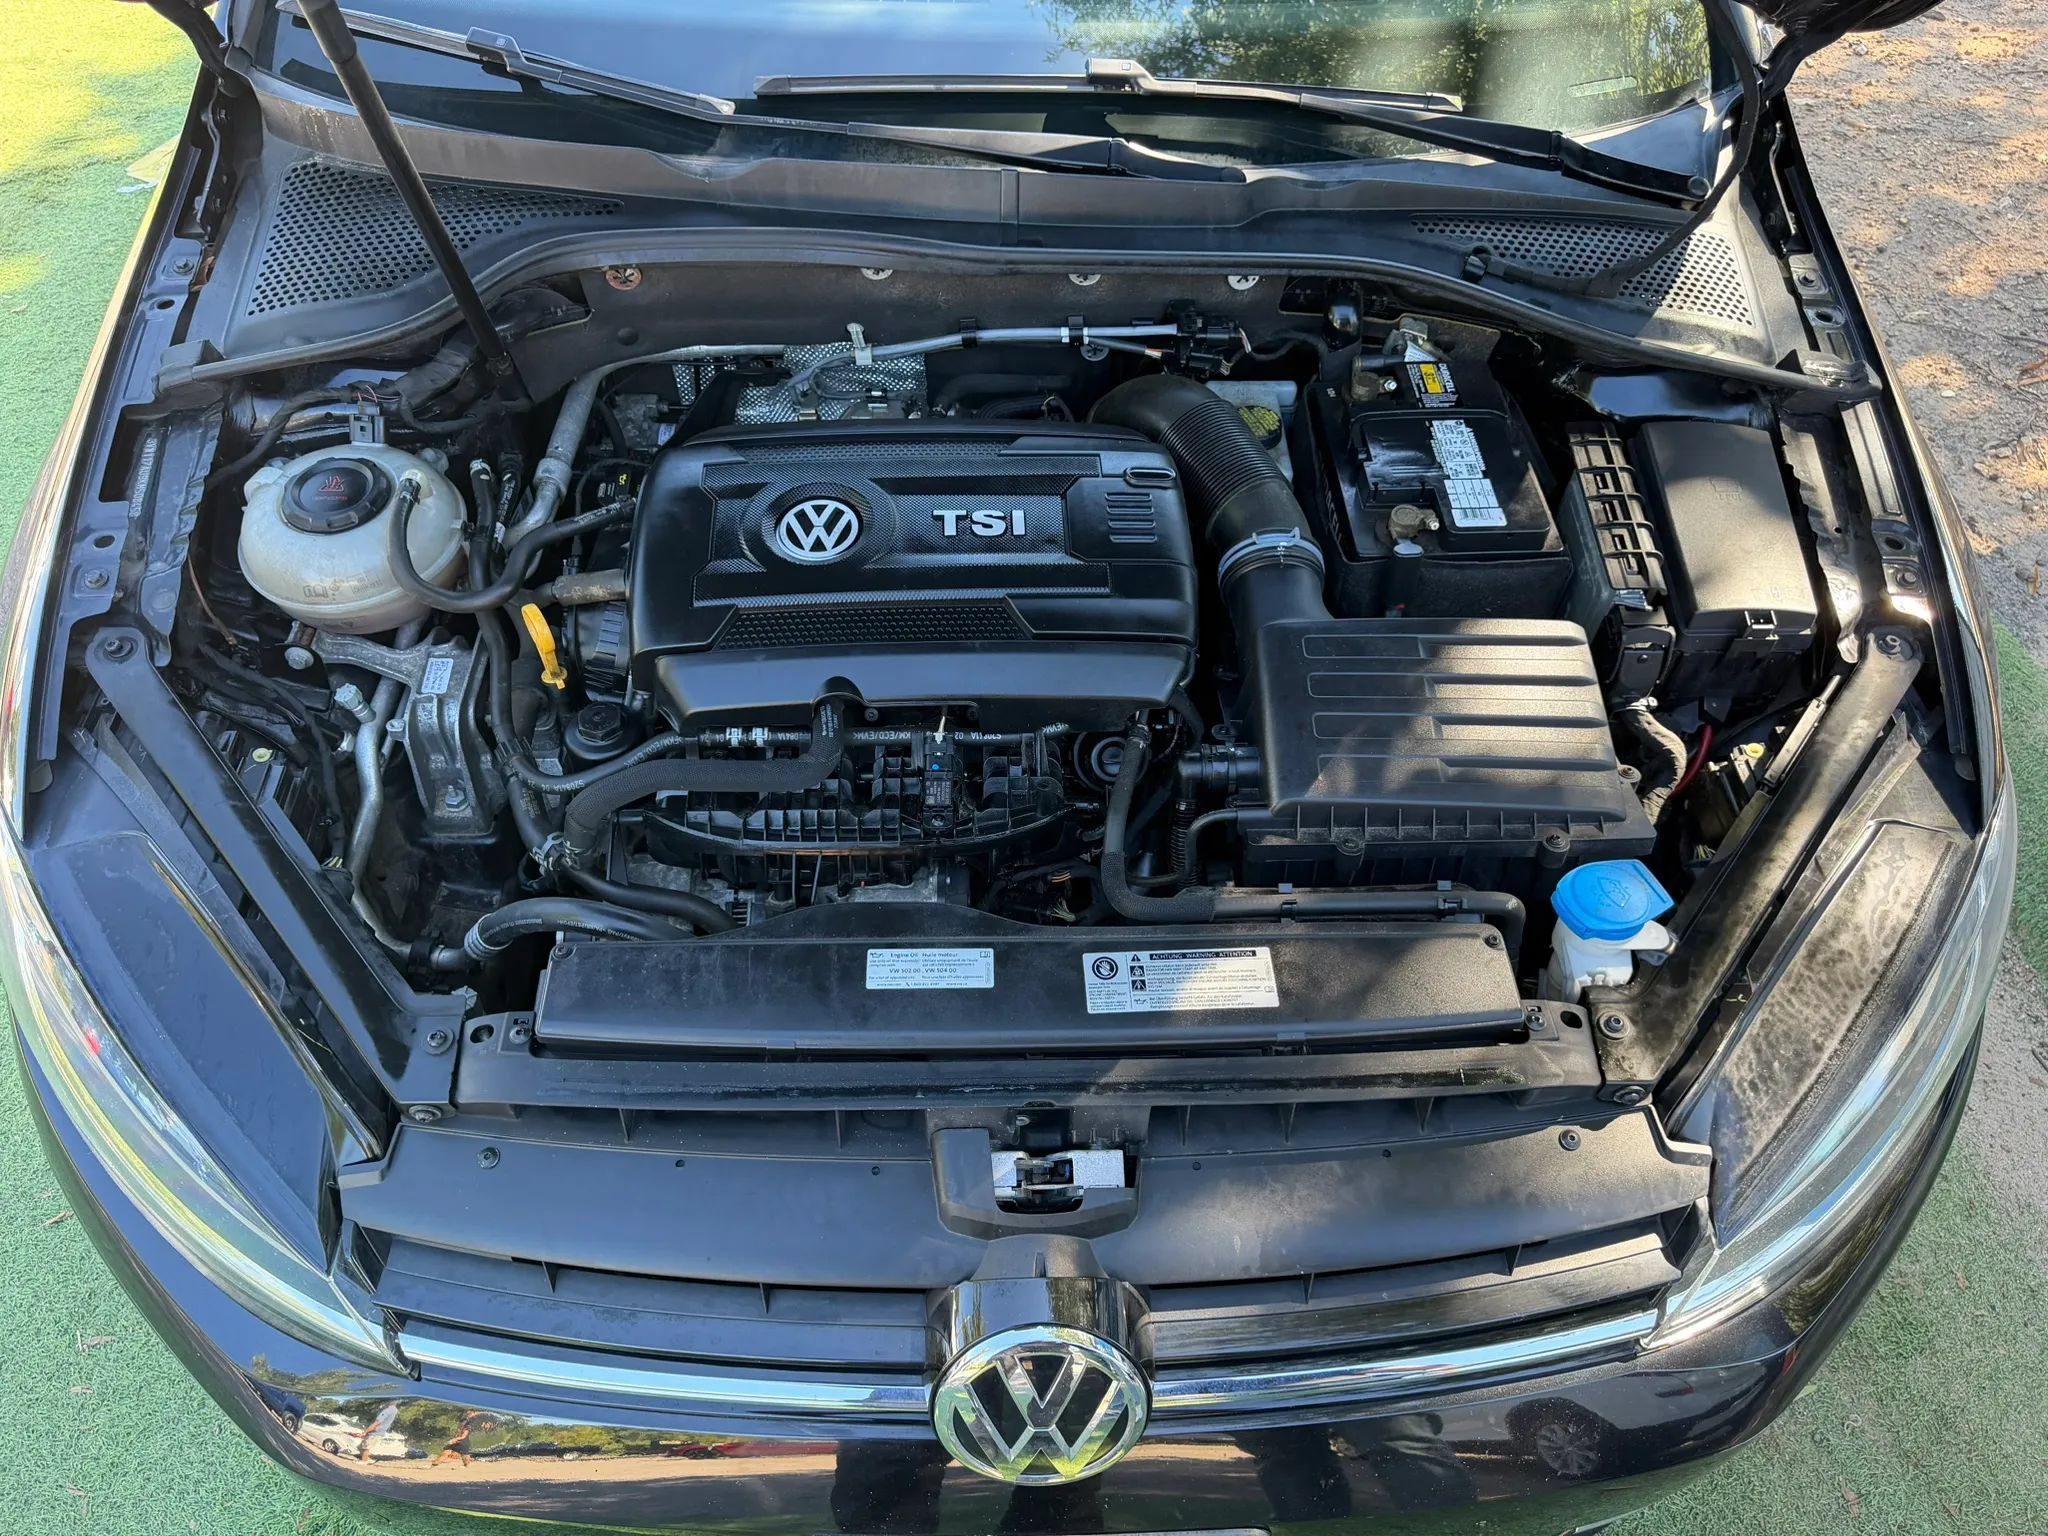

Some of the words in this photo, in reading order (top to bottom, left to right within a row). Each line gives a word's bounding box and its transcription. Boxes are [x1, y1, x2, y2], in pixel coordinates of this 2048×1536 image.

[777, 499, 859, 561] VW
[933, 509, 1026, 536] TSI
[1219, 950, 1253, 958] ATTENTION
[934, 1326, 1148, 1486] VW
